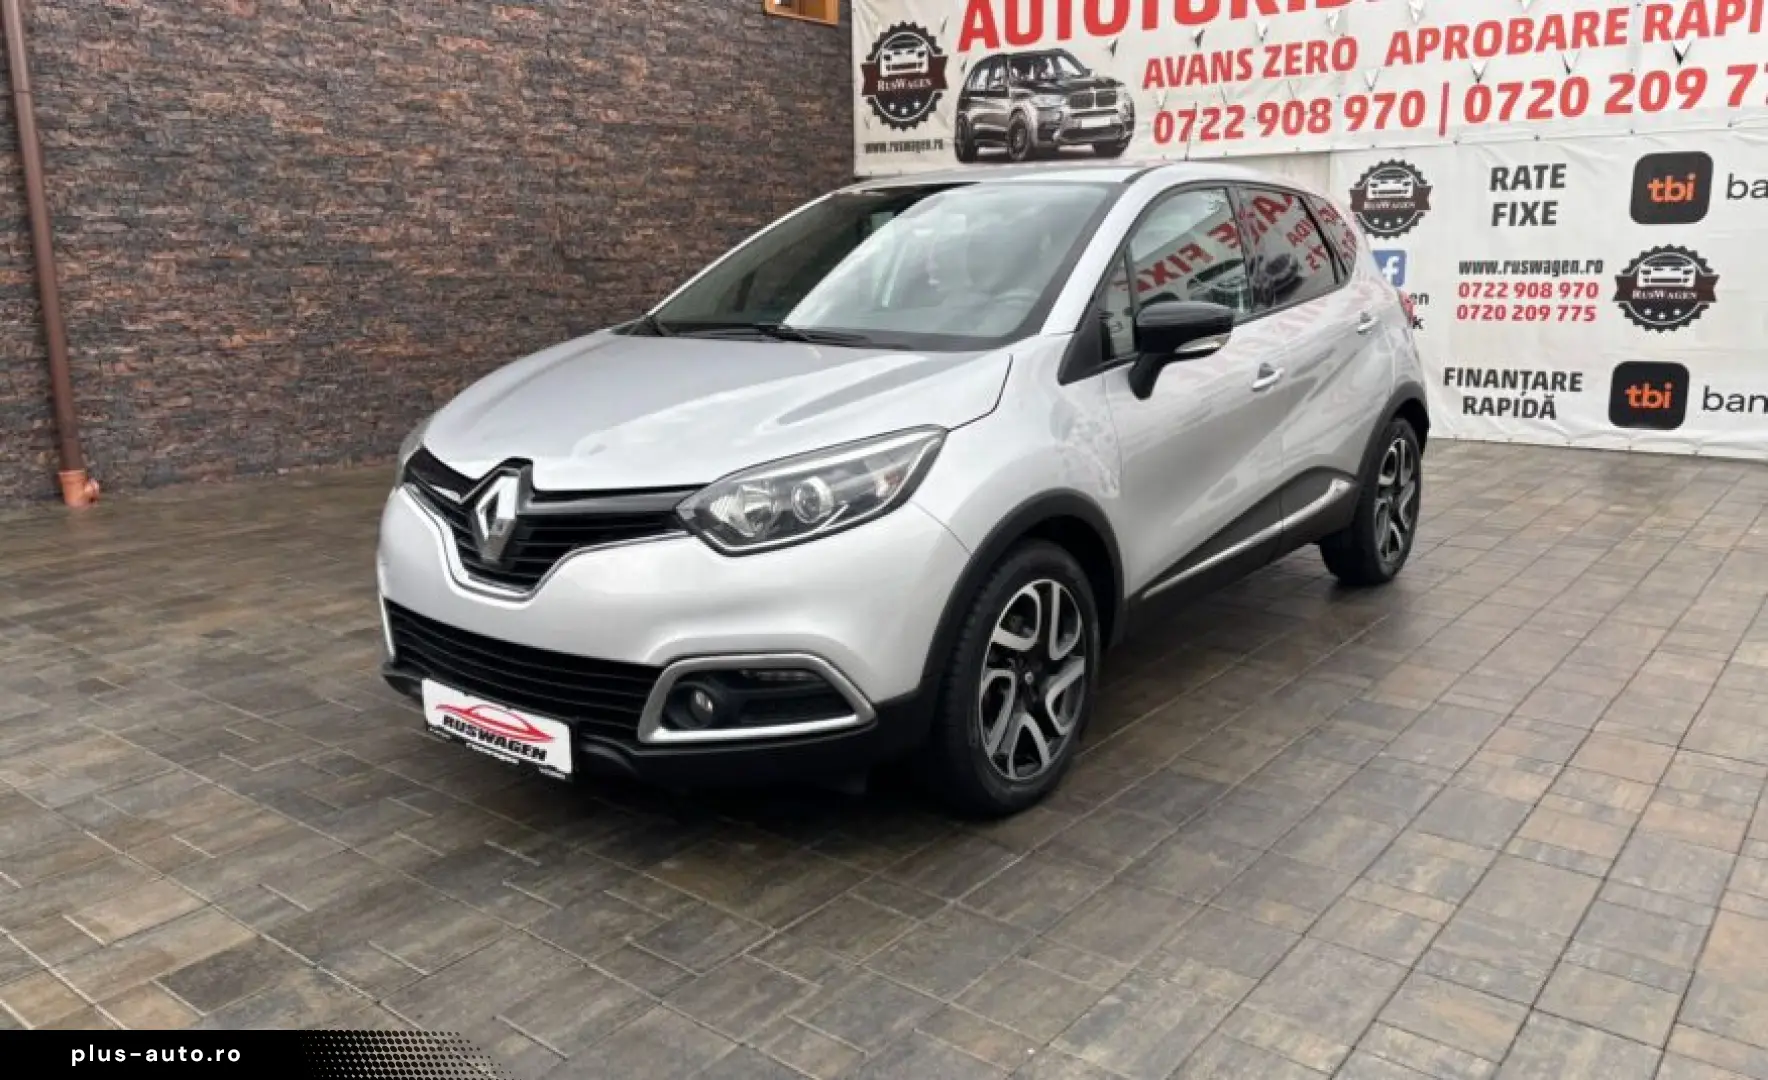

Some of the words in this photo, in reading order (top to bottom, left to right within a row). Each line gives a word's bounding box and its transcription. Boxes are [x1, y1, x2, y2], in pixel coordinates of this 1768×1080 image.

[1142, 47, 1255, 90] AVANS
[1261, 36, 1359, 79] ZERO
[1384, 7, 1631, 67] APROBARE
[1153, 104, 1246, 145] 0722
[1256, 97, 1333, 138] 908
[1343, 89, 1427, 132] 970
[1463, 76, 1591, 124] 0720
[1604, 66, 1709, 116] 209
[1726, 63, 1768, 108] 7
[1490, 163, 1567, 192] RATE
[1647, 172, 1697, 203] tbi
[1491, 200, 1559, 227] FIXE
[1458, 259, 1604, 278] www.ruswagen.ro
[1459, 281, 1509, 299] 0722
[1513, 281, 1553, 299] 908
[1559, 281, 1600, 299] 970
[1457, 303, 1508, 321] 0720
[1511, 304, 1551, 322] 209
[1557, 304, 1597, 322] 775
[1462, 393, 1557, 421] RAPIDĂ
[1625, 382, 1673, 409] tbi
[443, 714, 549, 763] RUSWAGEN
